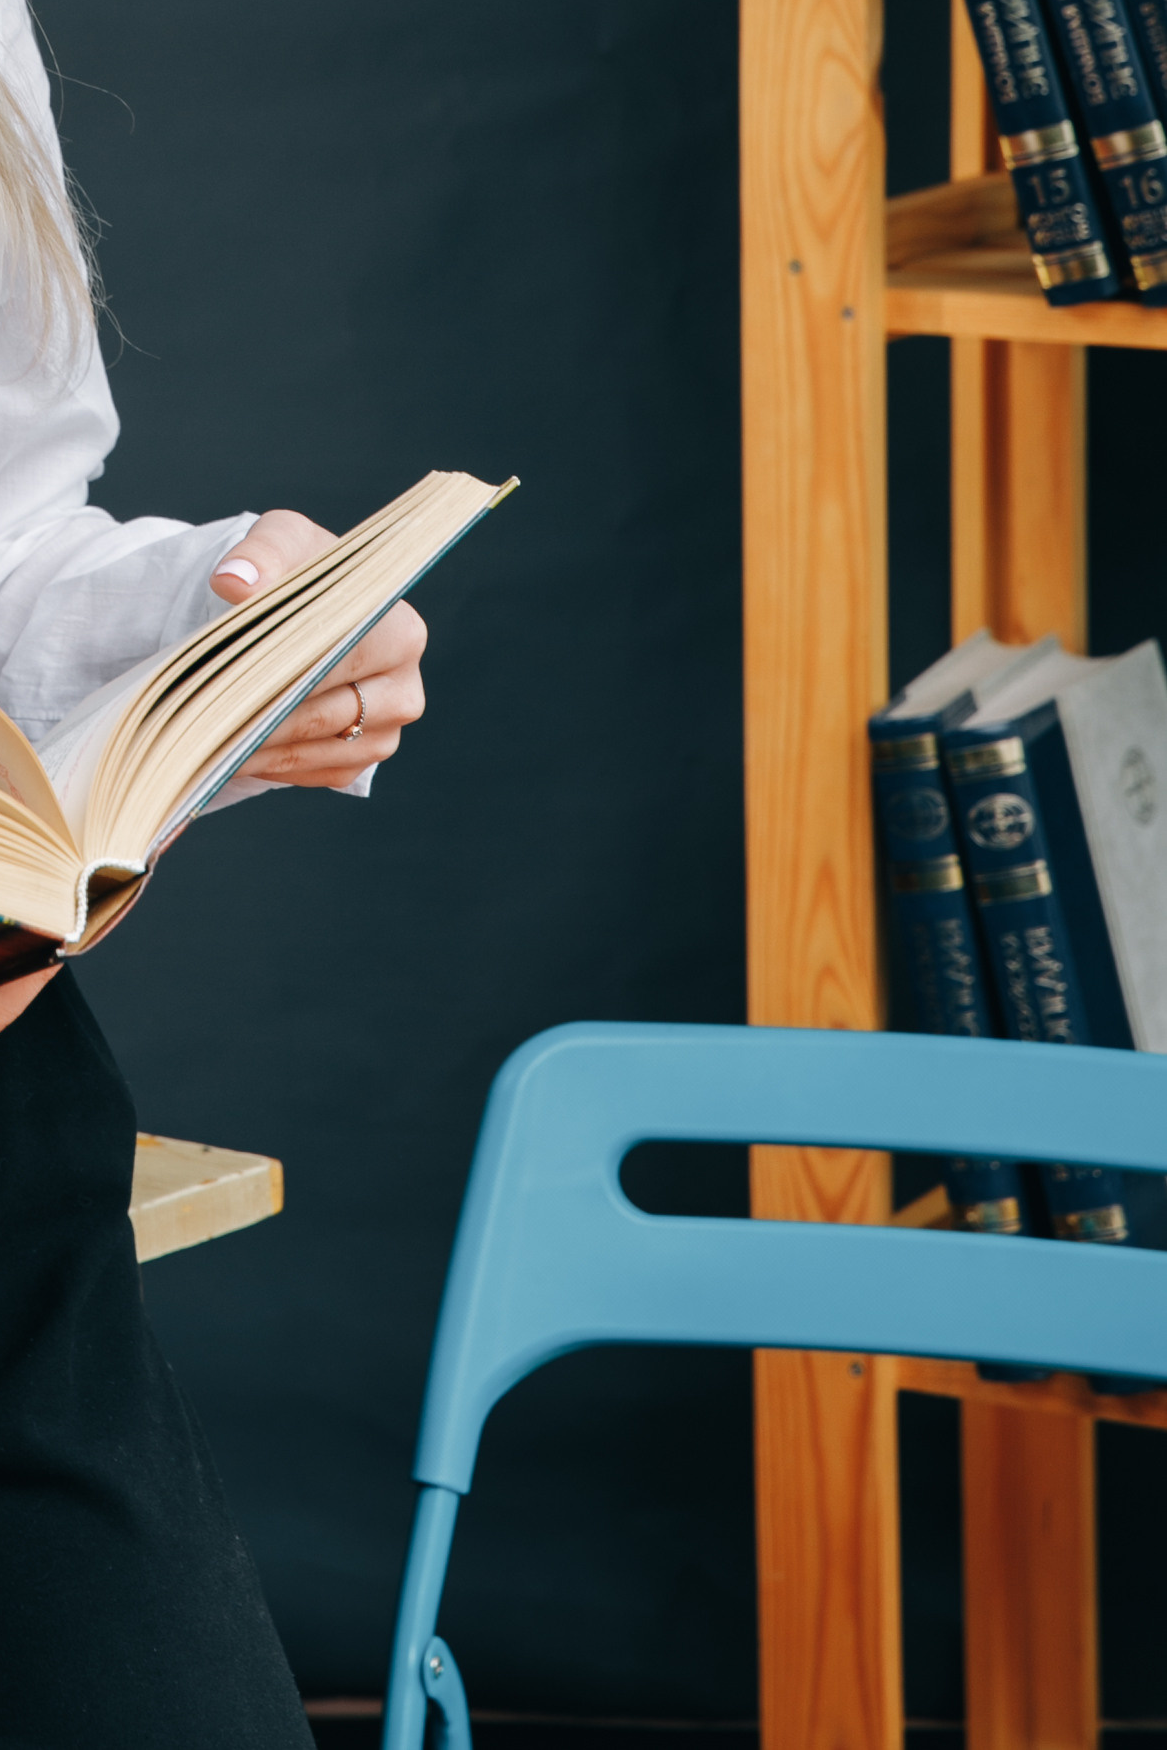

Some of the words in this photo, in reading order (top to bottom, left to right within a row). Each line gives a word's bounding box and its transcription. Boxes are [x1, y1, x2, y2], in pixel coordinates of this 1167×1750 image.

[978, 1, 1019, 104] БОЛЬШАЯ
[1061, 3, 1108, 105] БОЛЬШАЯ
[1029, 168, 1070, 206] 15
[1120, 168, 1164, 207] 16
